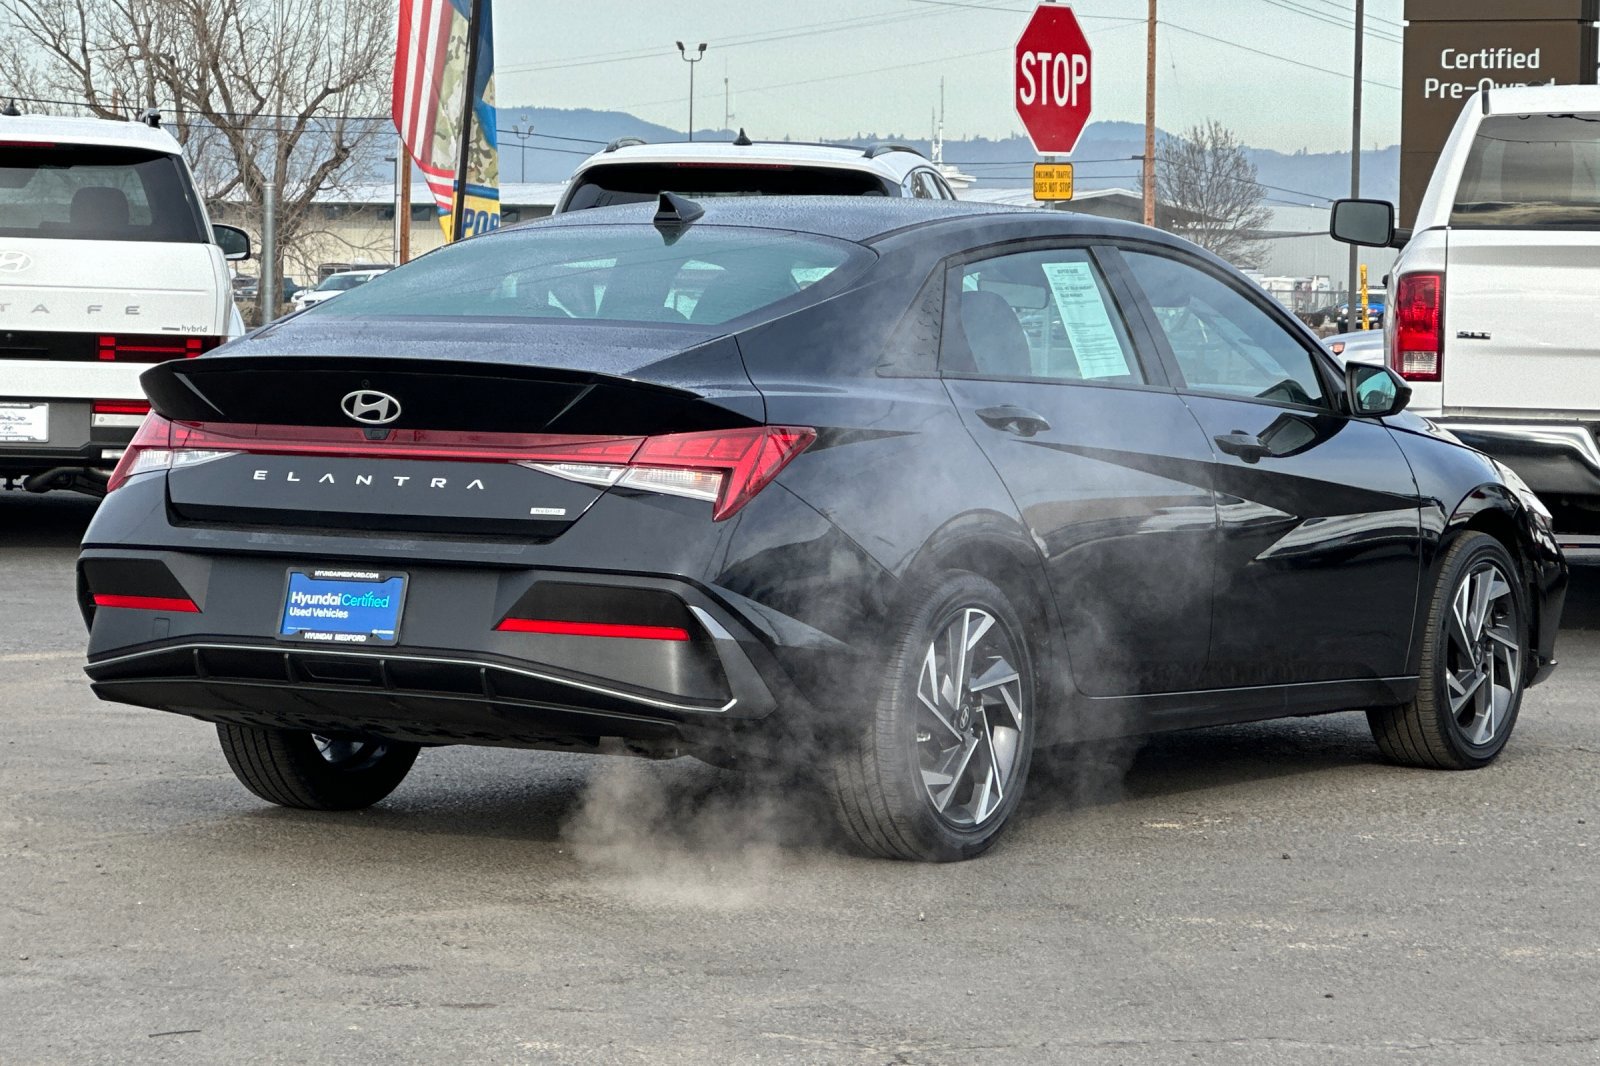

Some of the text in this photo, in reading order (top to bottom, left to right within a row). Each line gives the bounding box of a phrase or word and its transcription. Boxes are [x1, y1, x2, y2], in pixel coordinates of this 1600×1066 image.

[1441, 48, 1540, 69] Certified
[1019, 51, 1088, 107] STOP
[1056, 170, 1071, 179] TRAFFIC
[1035, 182, 1071, 193] DOES NOT STOP
[181, 324, 208, 333] hybrid
[1456, 330, 1491, 339] SLT
[253, 470, 485, 490] ELANTRA
[291, 591, 390, 608] Hyundai Certified
[289, 607, 349, 618] Used Vehicles
[304, 632, 367, 642] HYUNDAI MEDFORD
